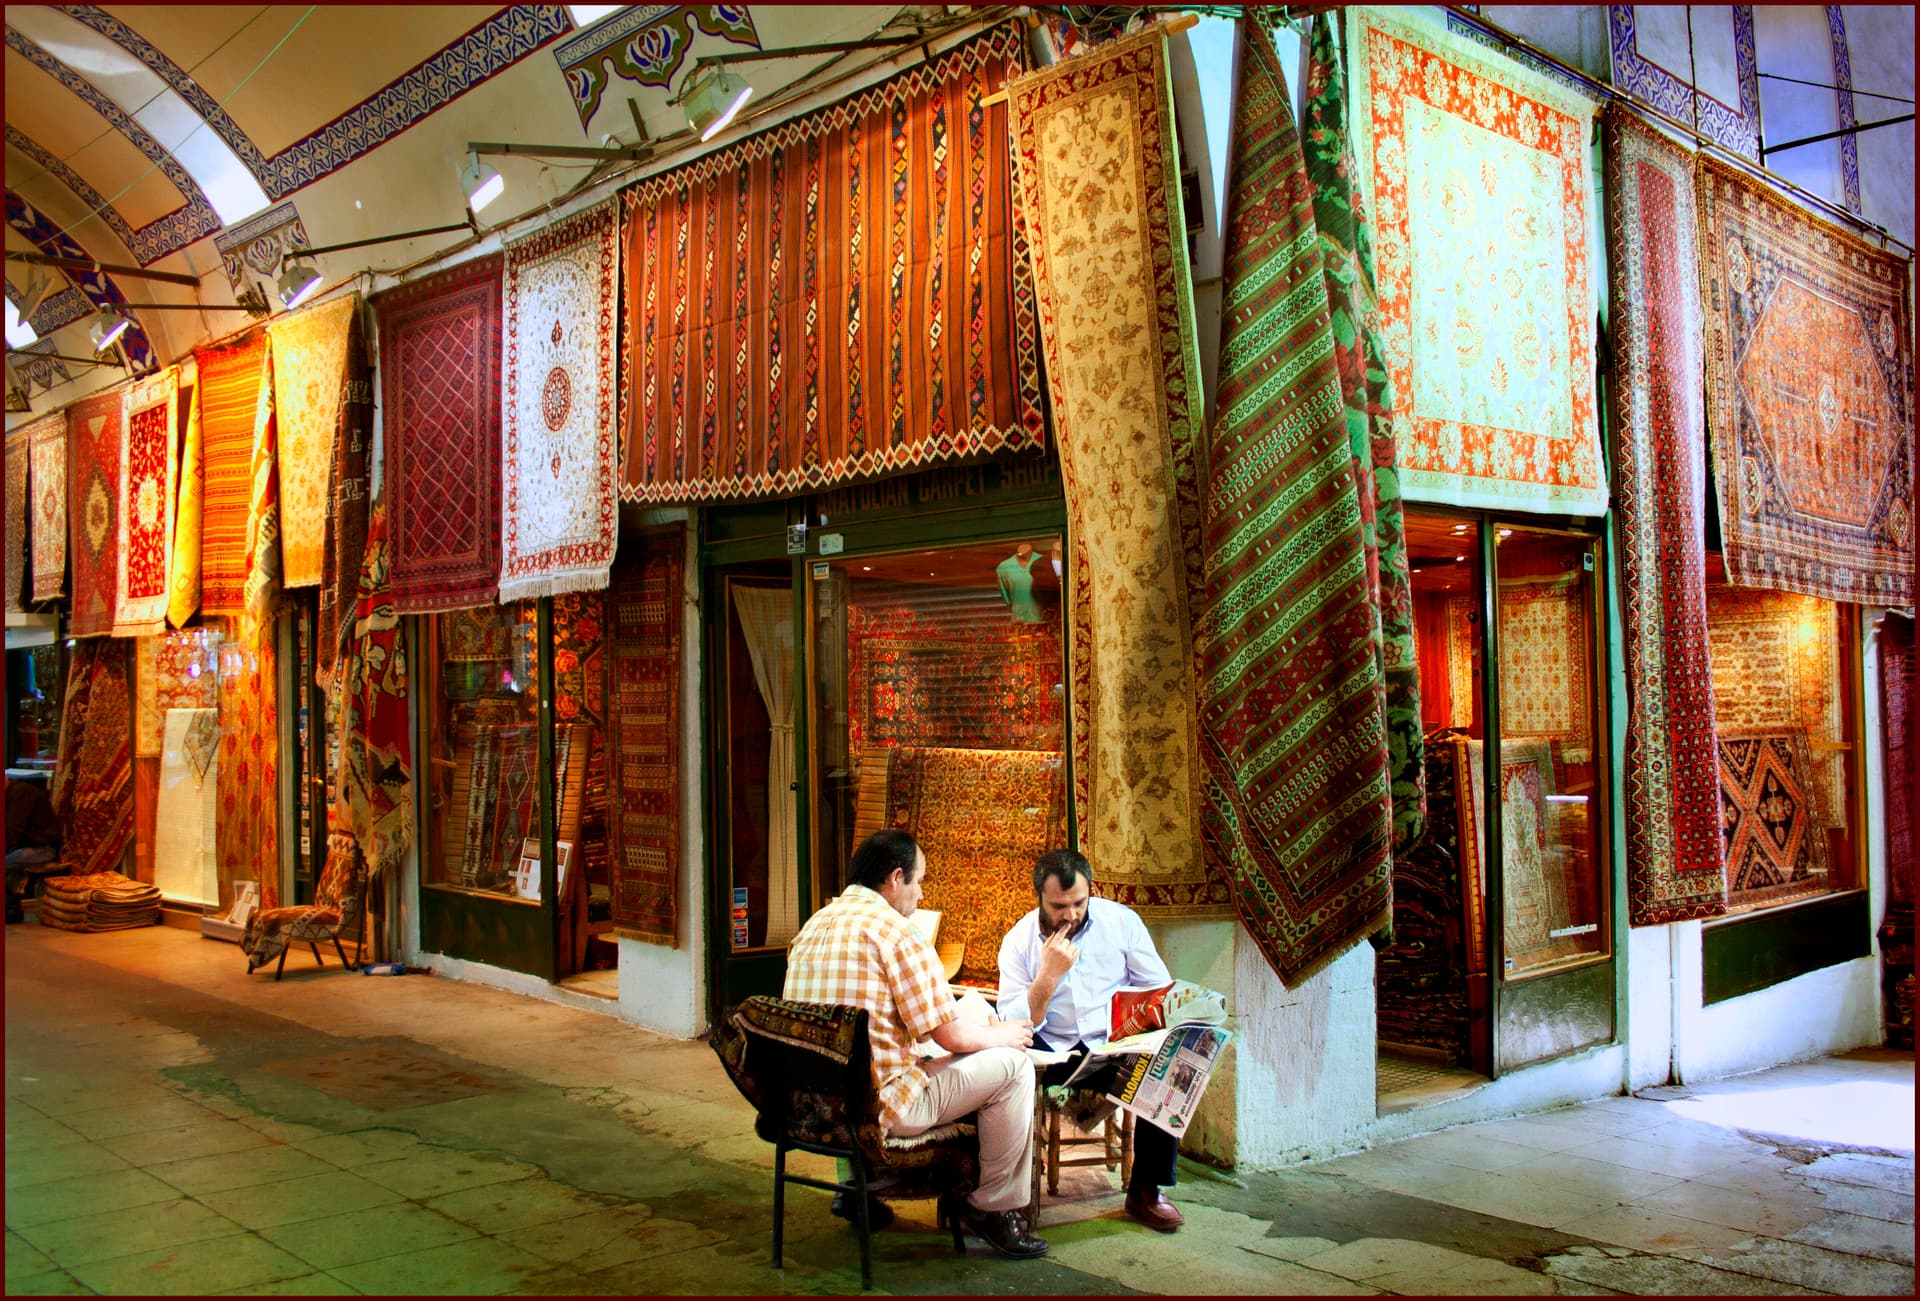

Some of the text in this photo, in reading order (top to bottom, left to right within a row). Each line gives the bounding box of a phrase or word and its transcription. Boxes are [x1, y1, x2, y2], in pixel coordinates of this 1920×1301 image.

[919, 464, 985, 503] CARPET
[1000, 456, 1056, 489] SHOP
[1151, 1030, 1180, 1078] tanbul
[1120, 1057, 1149, 1103] KONVOYU
